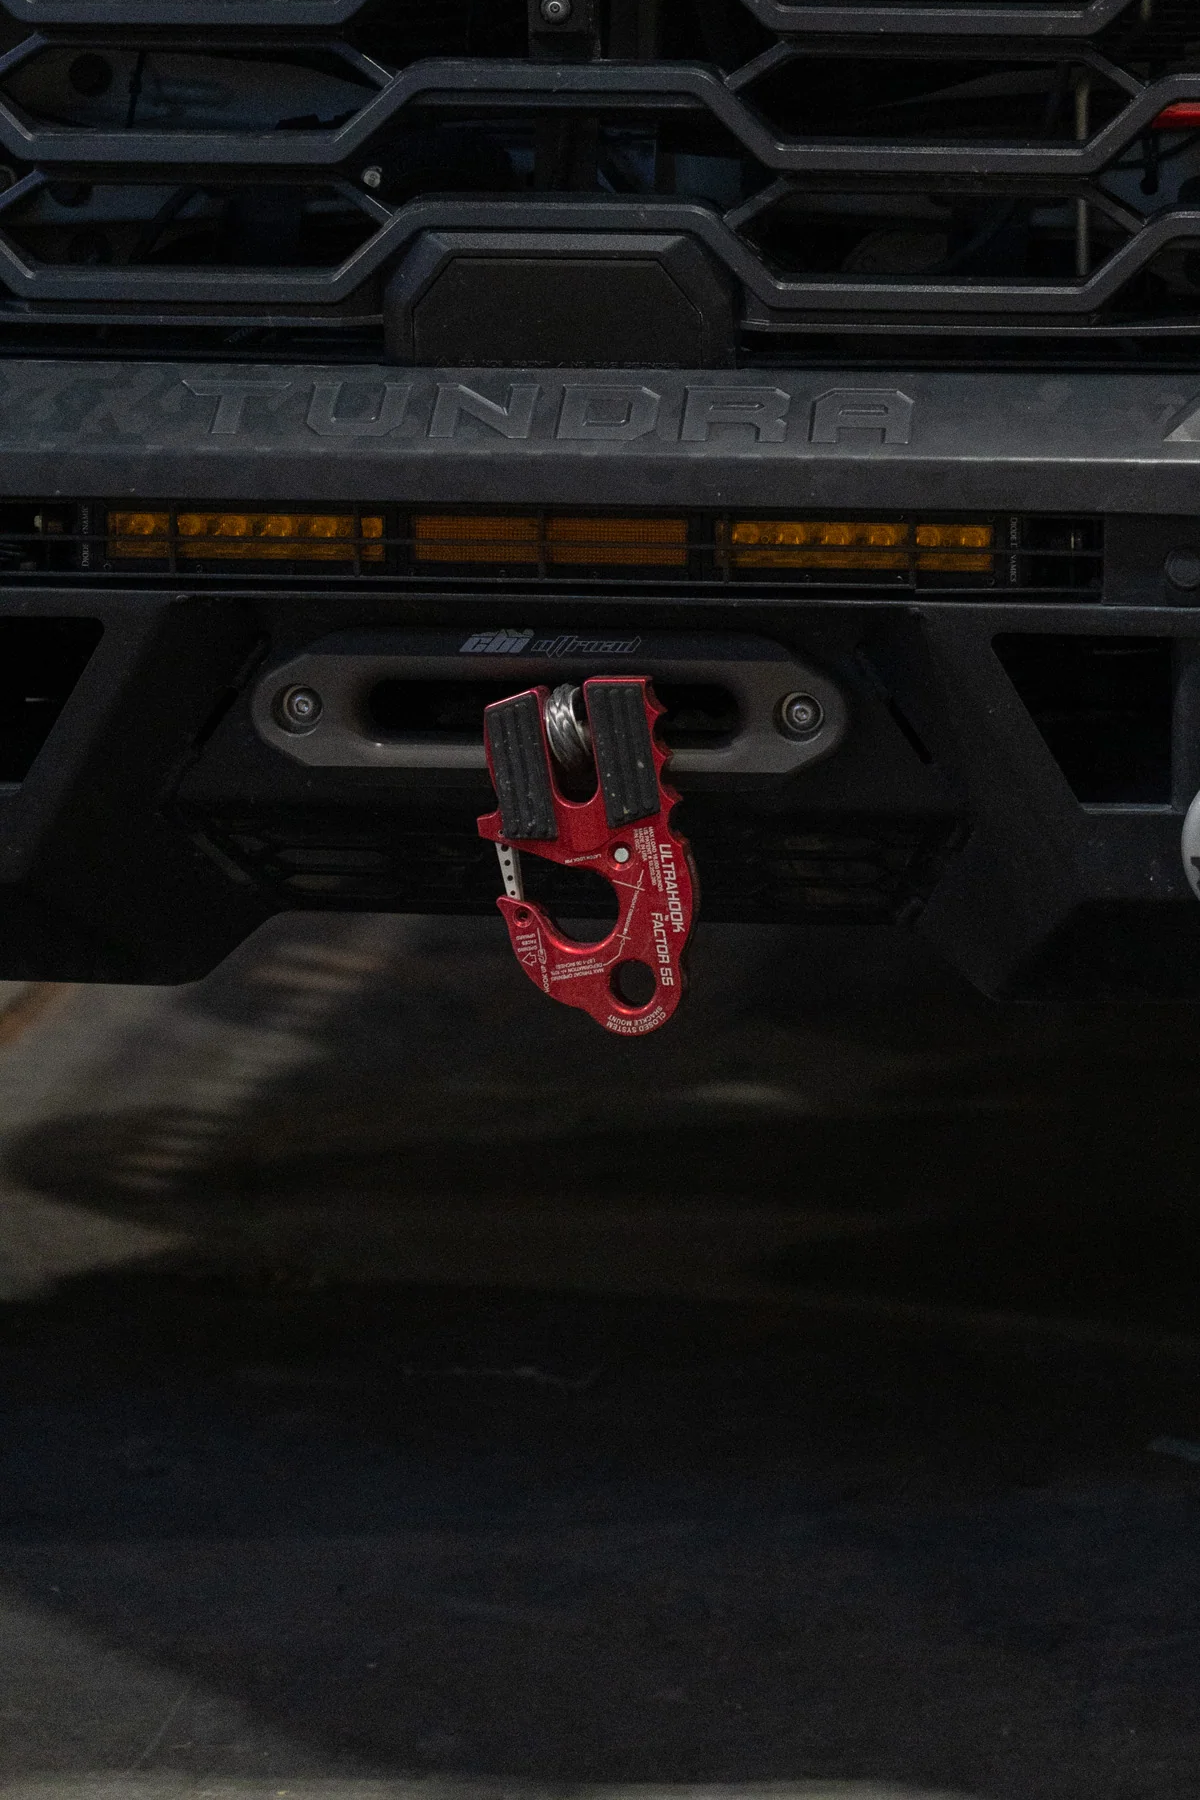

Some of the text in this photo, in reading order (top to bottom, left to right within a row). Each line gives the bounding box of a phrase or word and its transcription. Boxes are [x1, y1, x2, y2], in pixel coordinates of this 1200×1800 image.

[181, 379, 915, 446] TUNDRA
[658, 843, 686, 933] ULTRAHOOK
[650, 912, 674, 986] FACTOR 55
[541, 973, 550, 993] HOOK
[606, 1011, 667, 1034] CLOSED SYSTEM
[607, 1005, 663, 1026] SHACKLE MOUNT
